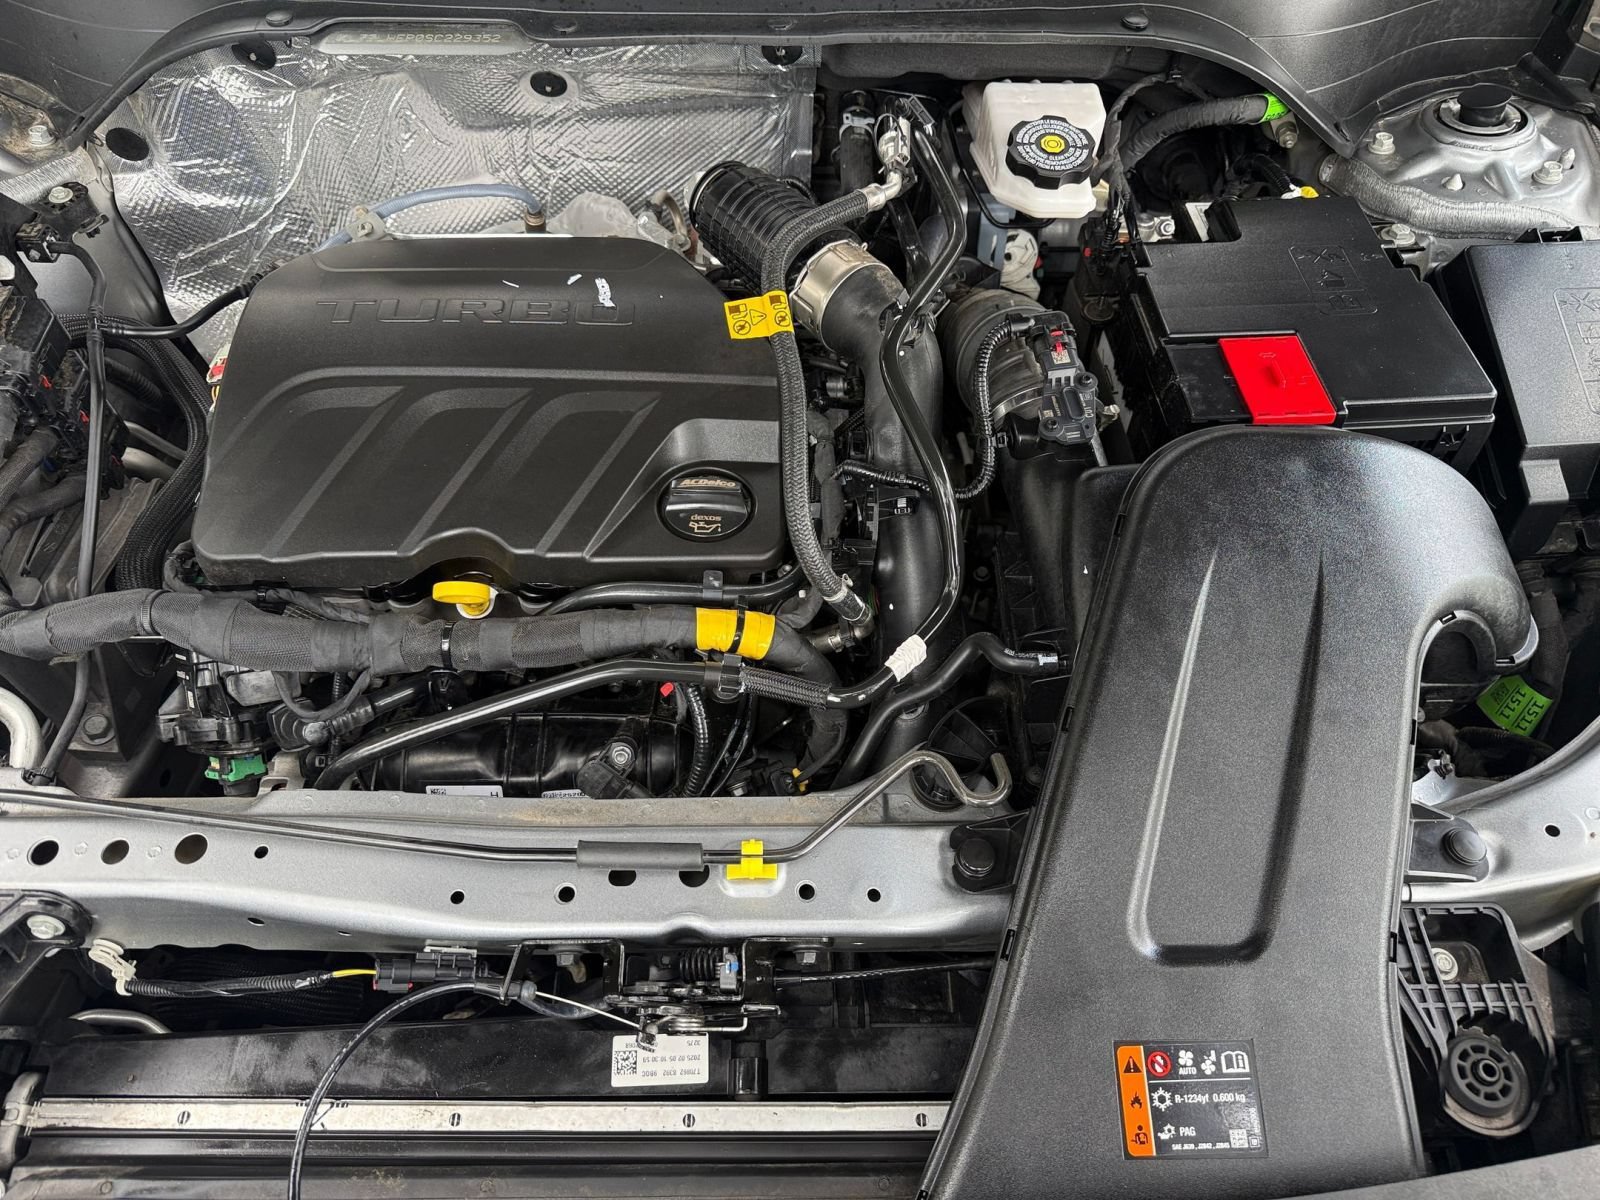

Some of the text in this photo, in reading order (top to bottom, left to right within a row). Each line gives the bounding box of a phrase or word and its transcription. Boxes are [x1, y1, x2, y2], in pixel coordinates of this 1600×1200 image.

[317, 299, 635, 327] TURBO
[680, 479, 736, 487] ACDelco
[690, 513, 722, 521] dexos
[1499, 687, 1527, 720] 1511
[1515, 700, 1544, 732] 1511
[1178, 1067, 1197, 1075] AUTO
[1174, 1092, 1246, 1104] R-1234yf 0.600 kg
[1179, 1126, 1196, 1137] PAG
